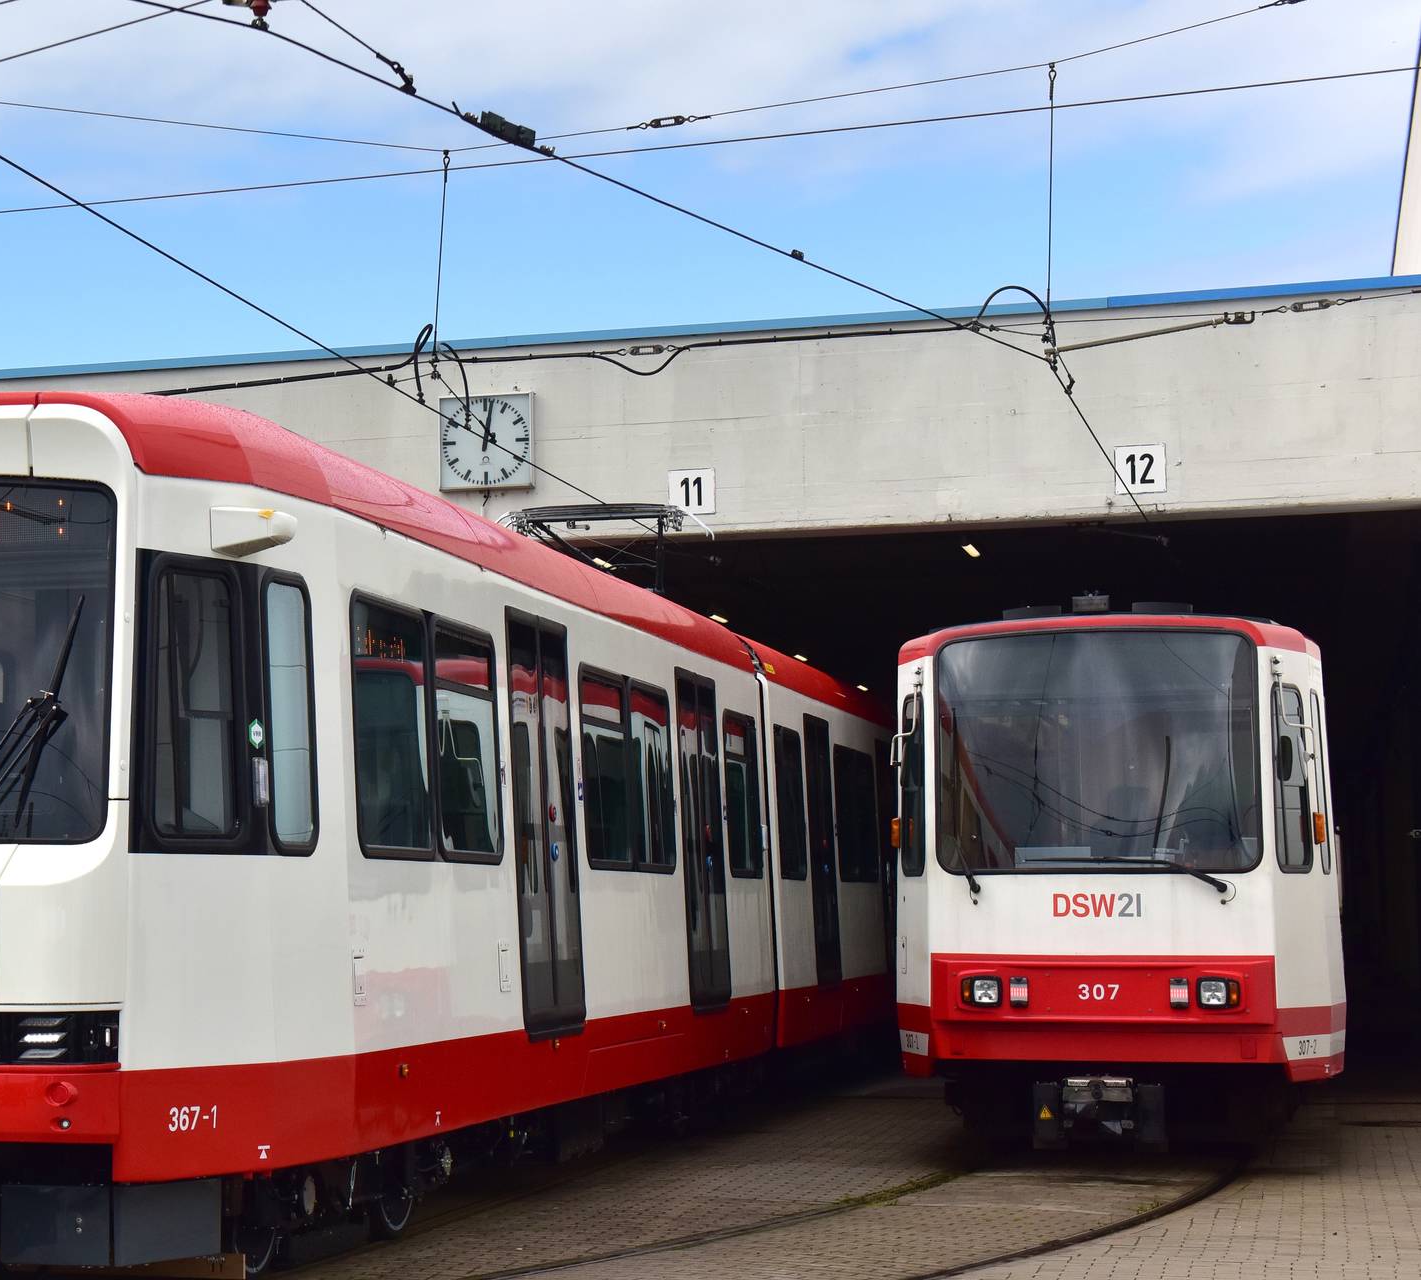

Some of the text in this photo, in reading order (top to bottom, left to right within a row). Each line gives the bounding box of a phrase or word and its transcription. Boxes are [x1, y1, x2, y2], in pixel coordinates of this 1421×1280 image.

[1125, 453, 1155, 485] 12
[680, 477, 703, 507] 11
[1052, 892, 1142, 918] DSW21
[1078, 983, 1120, 1001] 307
[1298, 1039, 1317, 1056] 307-2
[168, 1104, 217, 1132] 367-1
